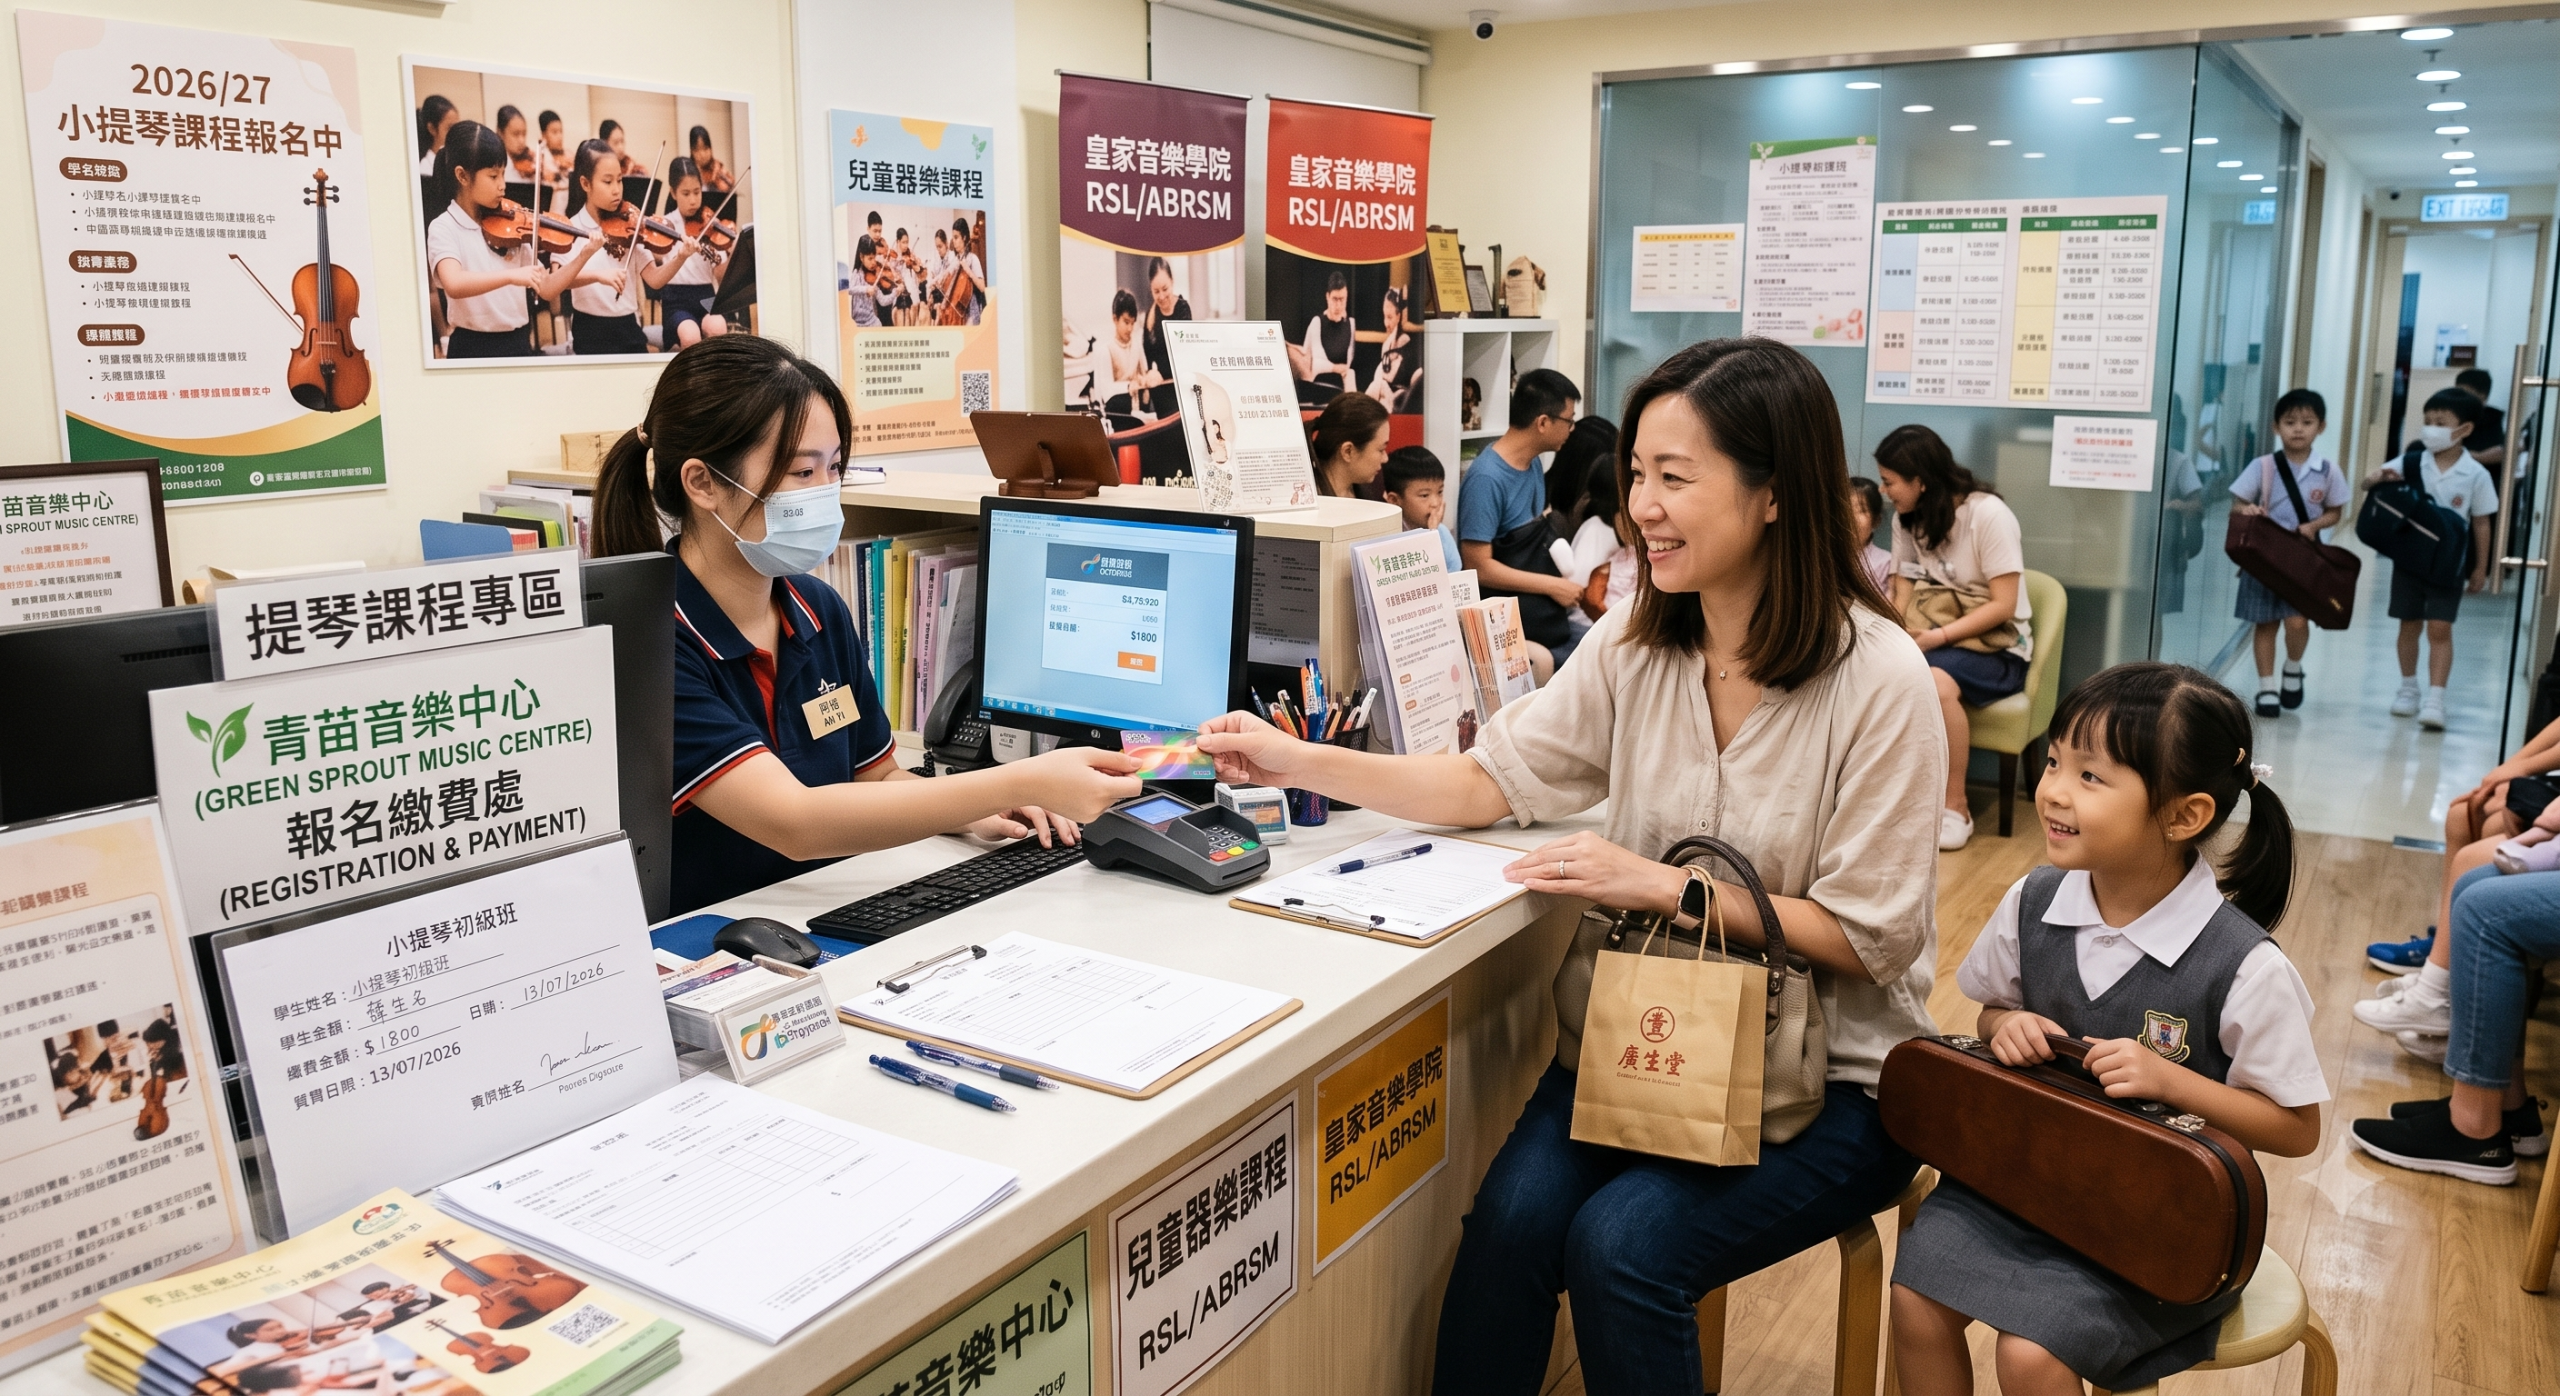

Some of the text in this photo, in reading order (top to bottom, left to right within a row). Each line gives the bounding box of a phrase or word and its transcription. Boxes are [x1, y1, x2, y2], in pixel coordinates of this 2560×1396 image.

[131, 63, 271, 107] 2026/27
[57, 103, 342, 158] 小提琴課程報名中
[848, 158, 985, 199] 兒童器樂課程
[1085, 133, 1232, 182] 皇家音樂學院
[1288, 153, 1416, 197] 皇家音樂學院
[1086, 180, 1232, 222] RSL/ABRSM
[1288, 196, 1415, 234] RSL/ABRSM
[2, 490, 114, 518] 苗音樂中心
[6, 514, 139, 534] SPROUT MUSIC CENTRE)
[244, 568, 565, 661] 提琴課程專區
[1131, 630, 1157, 643] $1800
[263, 678, 541, 766] 青苗音樂中心
[195, 718, 593, 821] (GREEN SPROUT MUSIC CENTRE)
[286, 769, 525, 860] 報名繳費處
[220, 806, 587, 921] (REGISTRATION & PAYMENT)
[386, 901, 519, 958] 小提琴初級班
[524, 961, 604, 1001] 13/07/2026
[370, 1041, 462, 1085] 13/07/2026
[1617, 1044, 1686, 1077] 廣生堂
[1323, 1044, 1445, 1165] 皇家音樂學院
[1330, 1098, 1438, 1205] RSL/ABRSM
[1125, 1132, 1288, 1303] 兒童器樂課程
[1139, 1231, 1281, 1372] RSL/ABRSM
[880, 1278, 1074, 1396] 音樂中心
